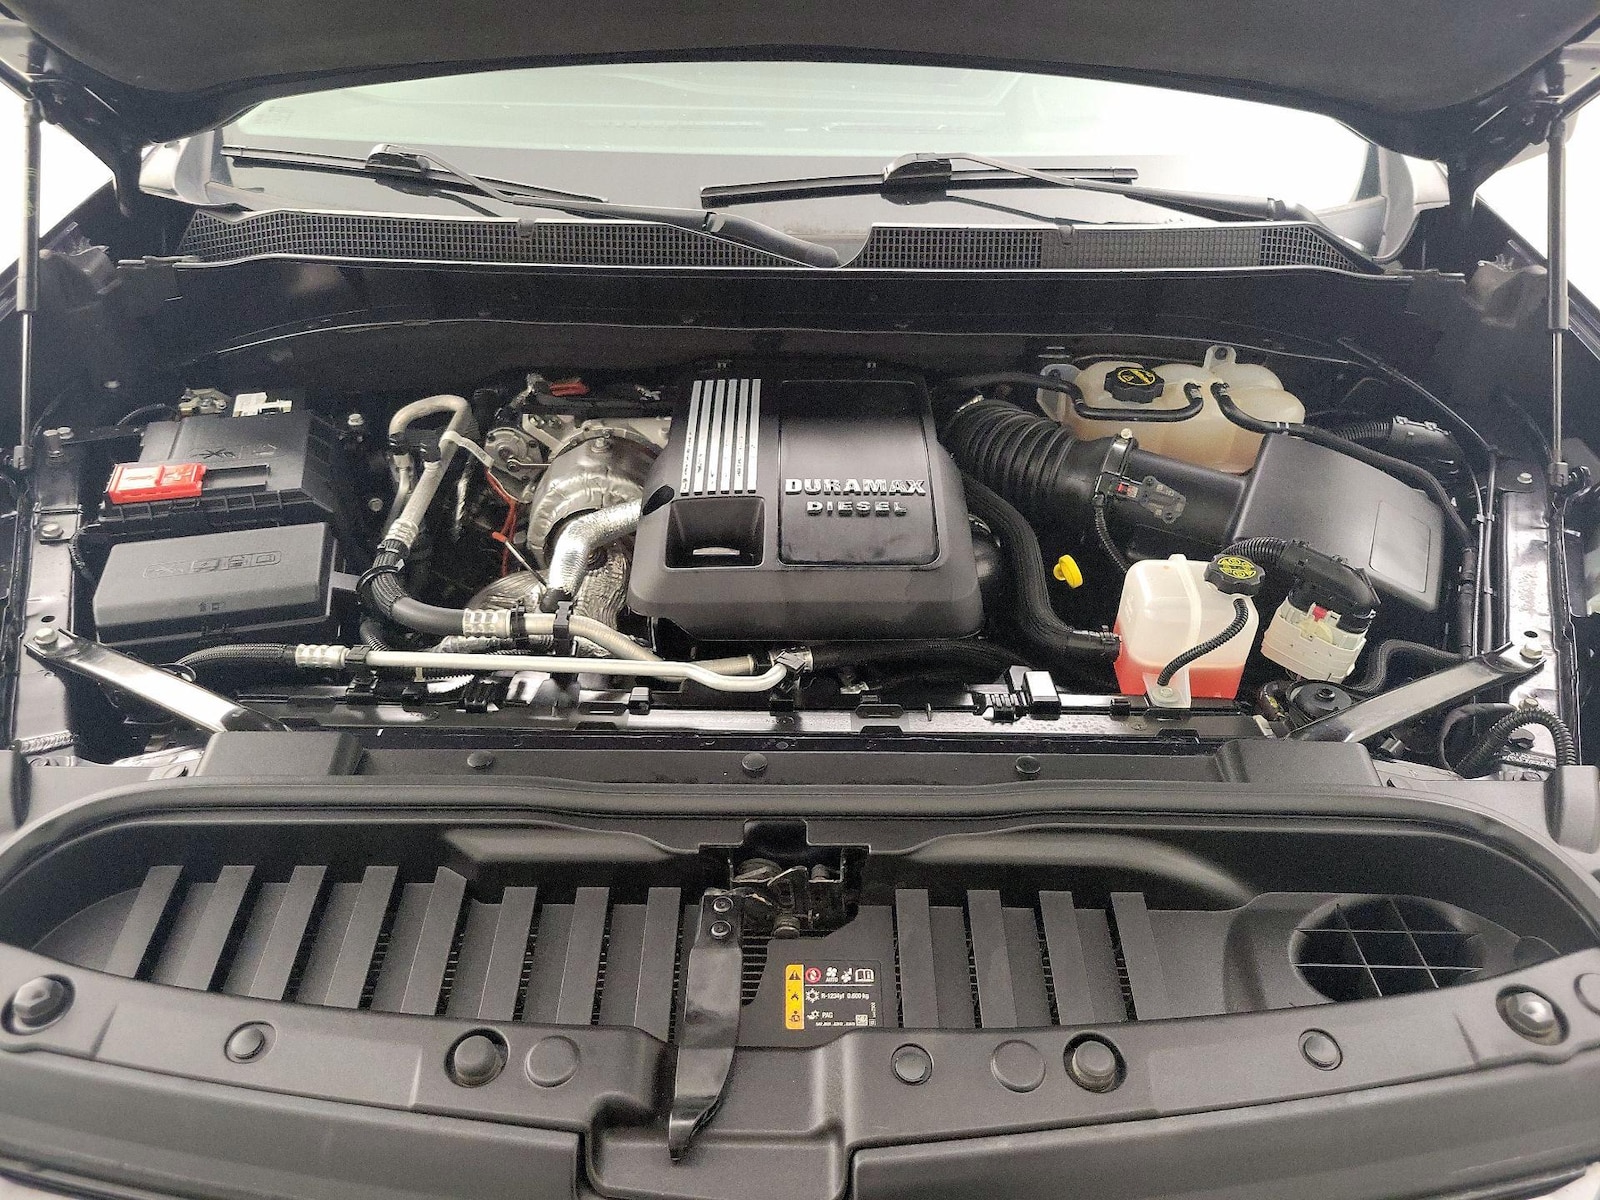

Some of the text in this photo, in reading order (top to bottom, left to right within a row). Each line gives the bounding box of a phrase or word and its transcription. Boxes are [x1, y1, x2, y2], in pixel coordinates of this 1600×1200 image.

[785, 478, 926, 496] DURAMAX
[806, 501, 907, 516] DIESEL
[821, 1011, 834, 1019] PAG
